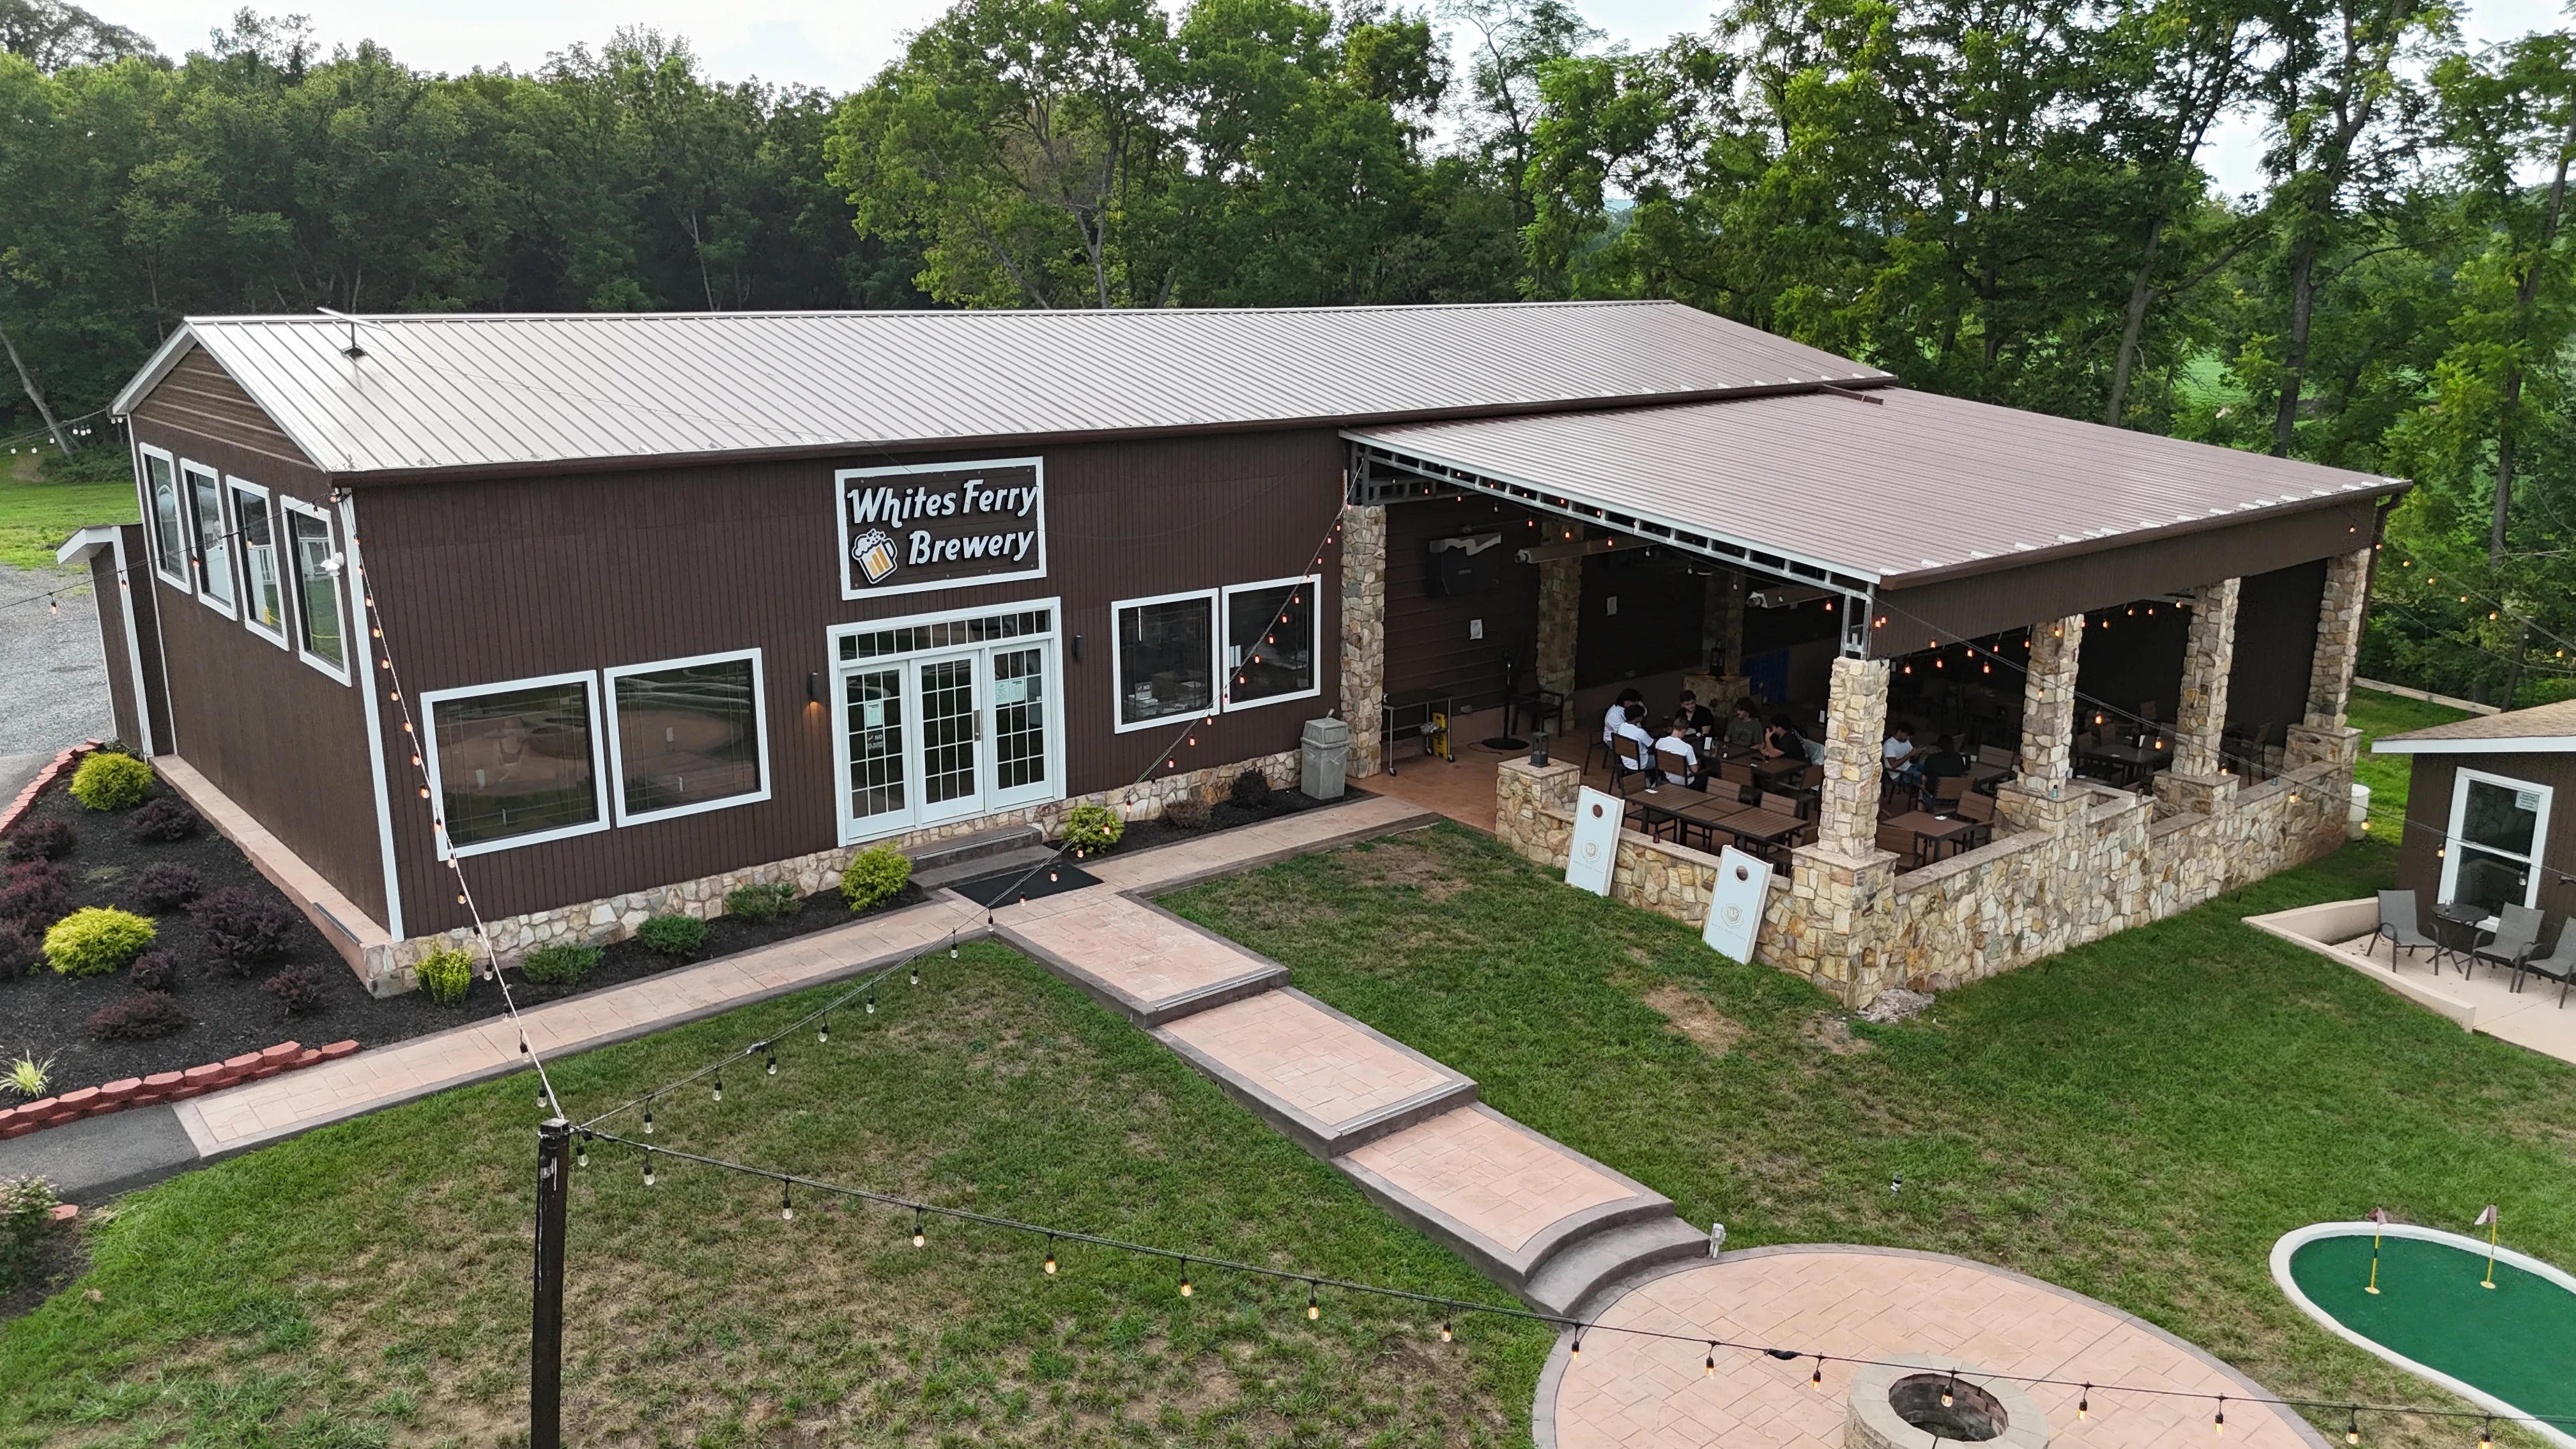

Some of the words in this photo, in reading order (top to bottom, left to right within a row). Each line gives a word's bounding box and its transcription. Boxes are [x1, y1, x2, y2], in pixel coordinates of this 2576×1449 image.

[847, 487, 956, 528] Whites
[963, 479, 1039, 518] Ferry
[908, 530, 1034, 564] Brewery
